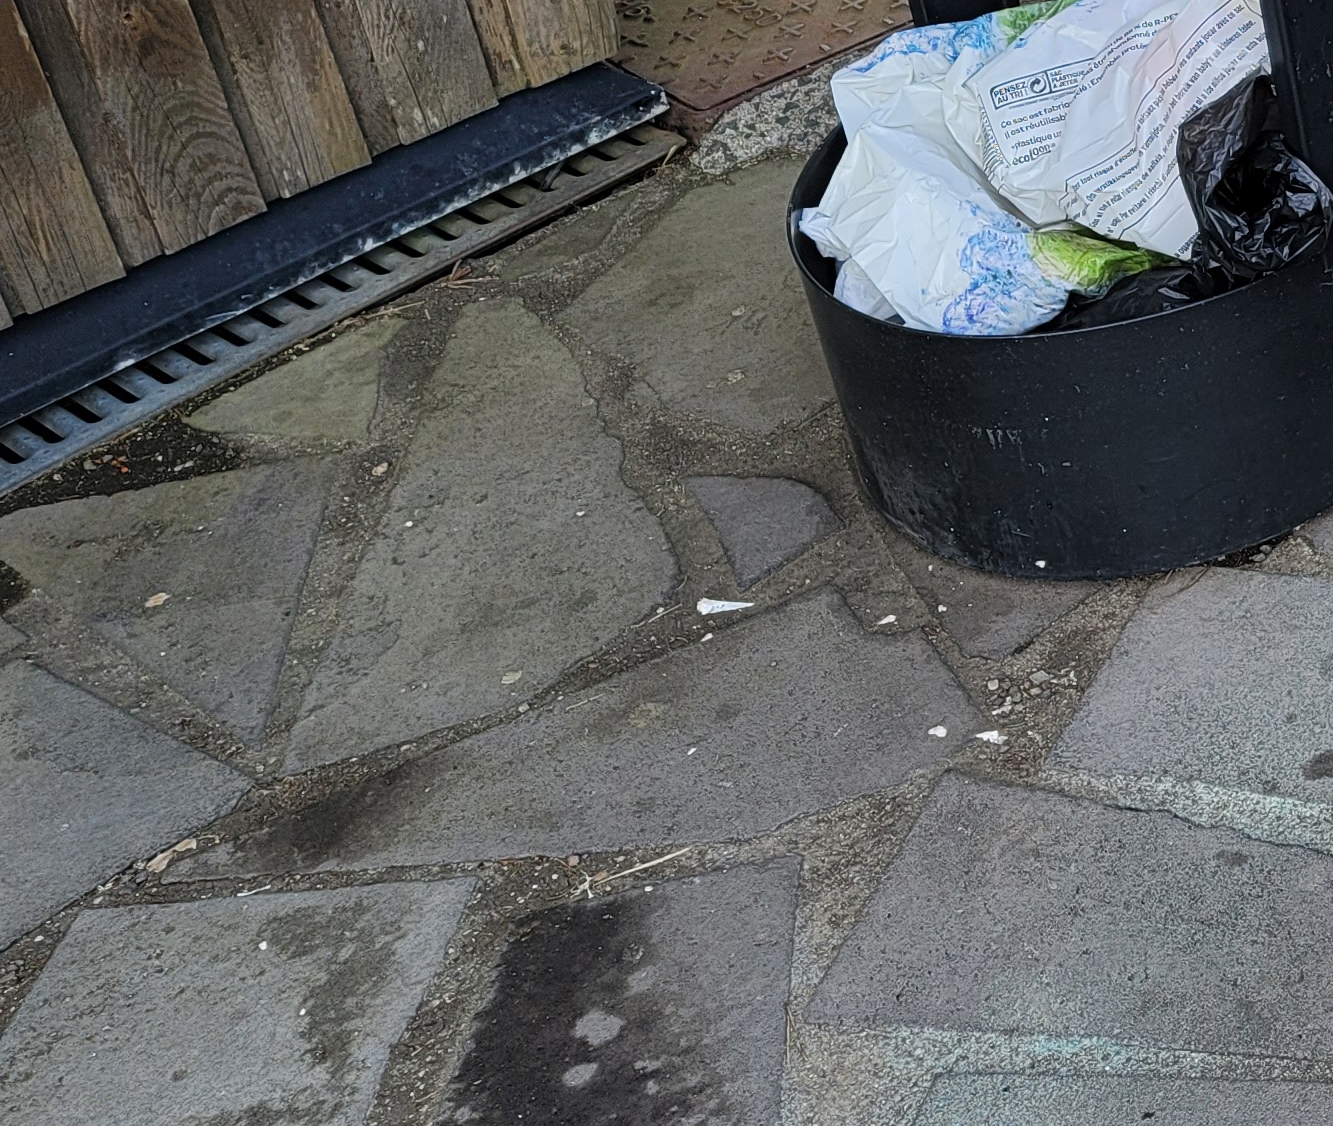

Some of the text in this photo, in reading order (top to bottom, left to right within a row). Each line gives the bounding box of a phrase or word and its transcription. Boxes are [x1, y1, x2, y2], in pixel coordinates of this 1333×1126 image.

[993, 81, 1027, 99] PENSEZ
[997, 95, 1009, 105] AU
[1025, 113, 1068, 131] réutilisab
